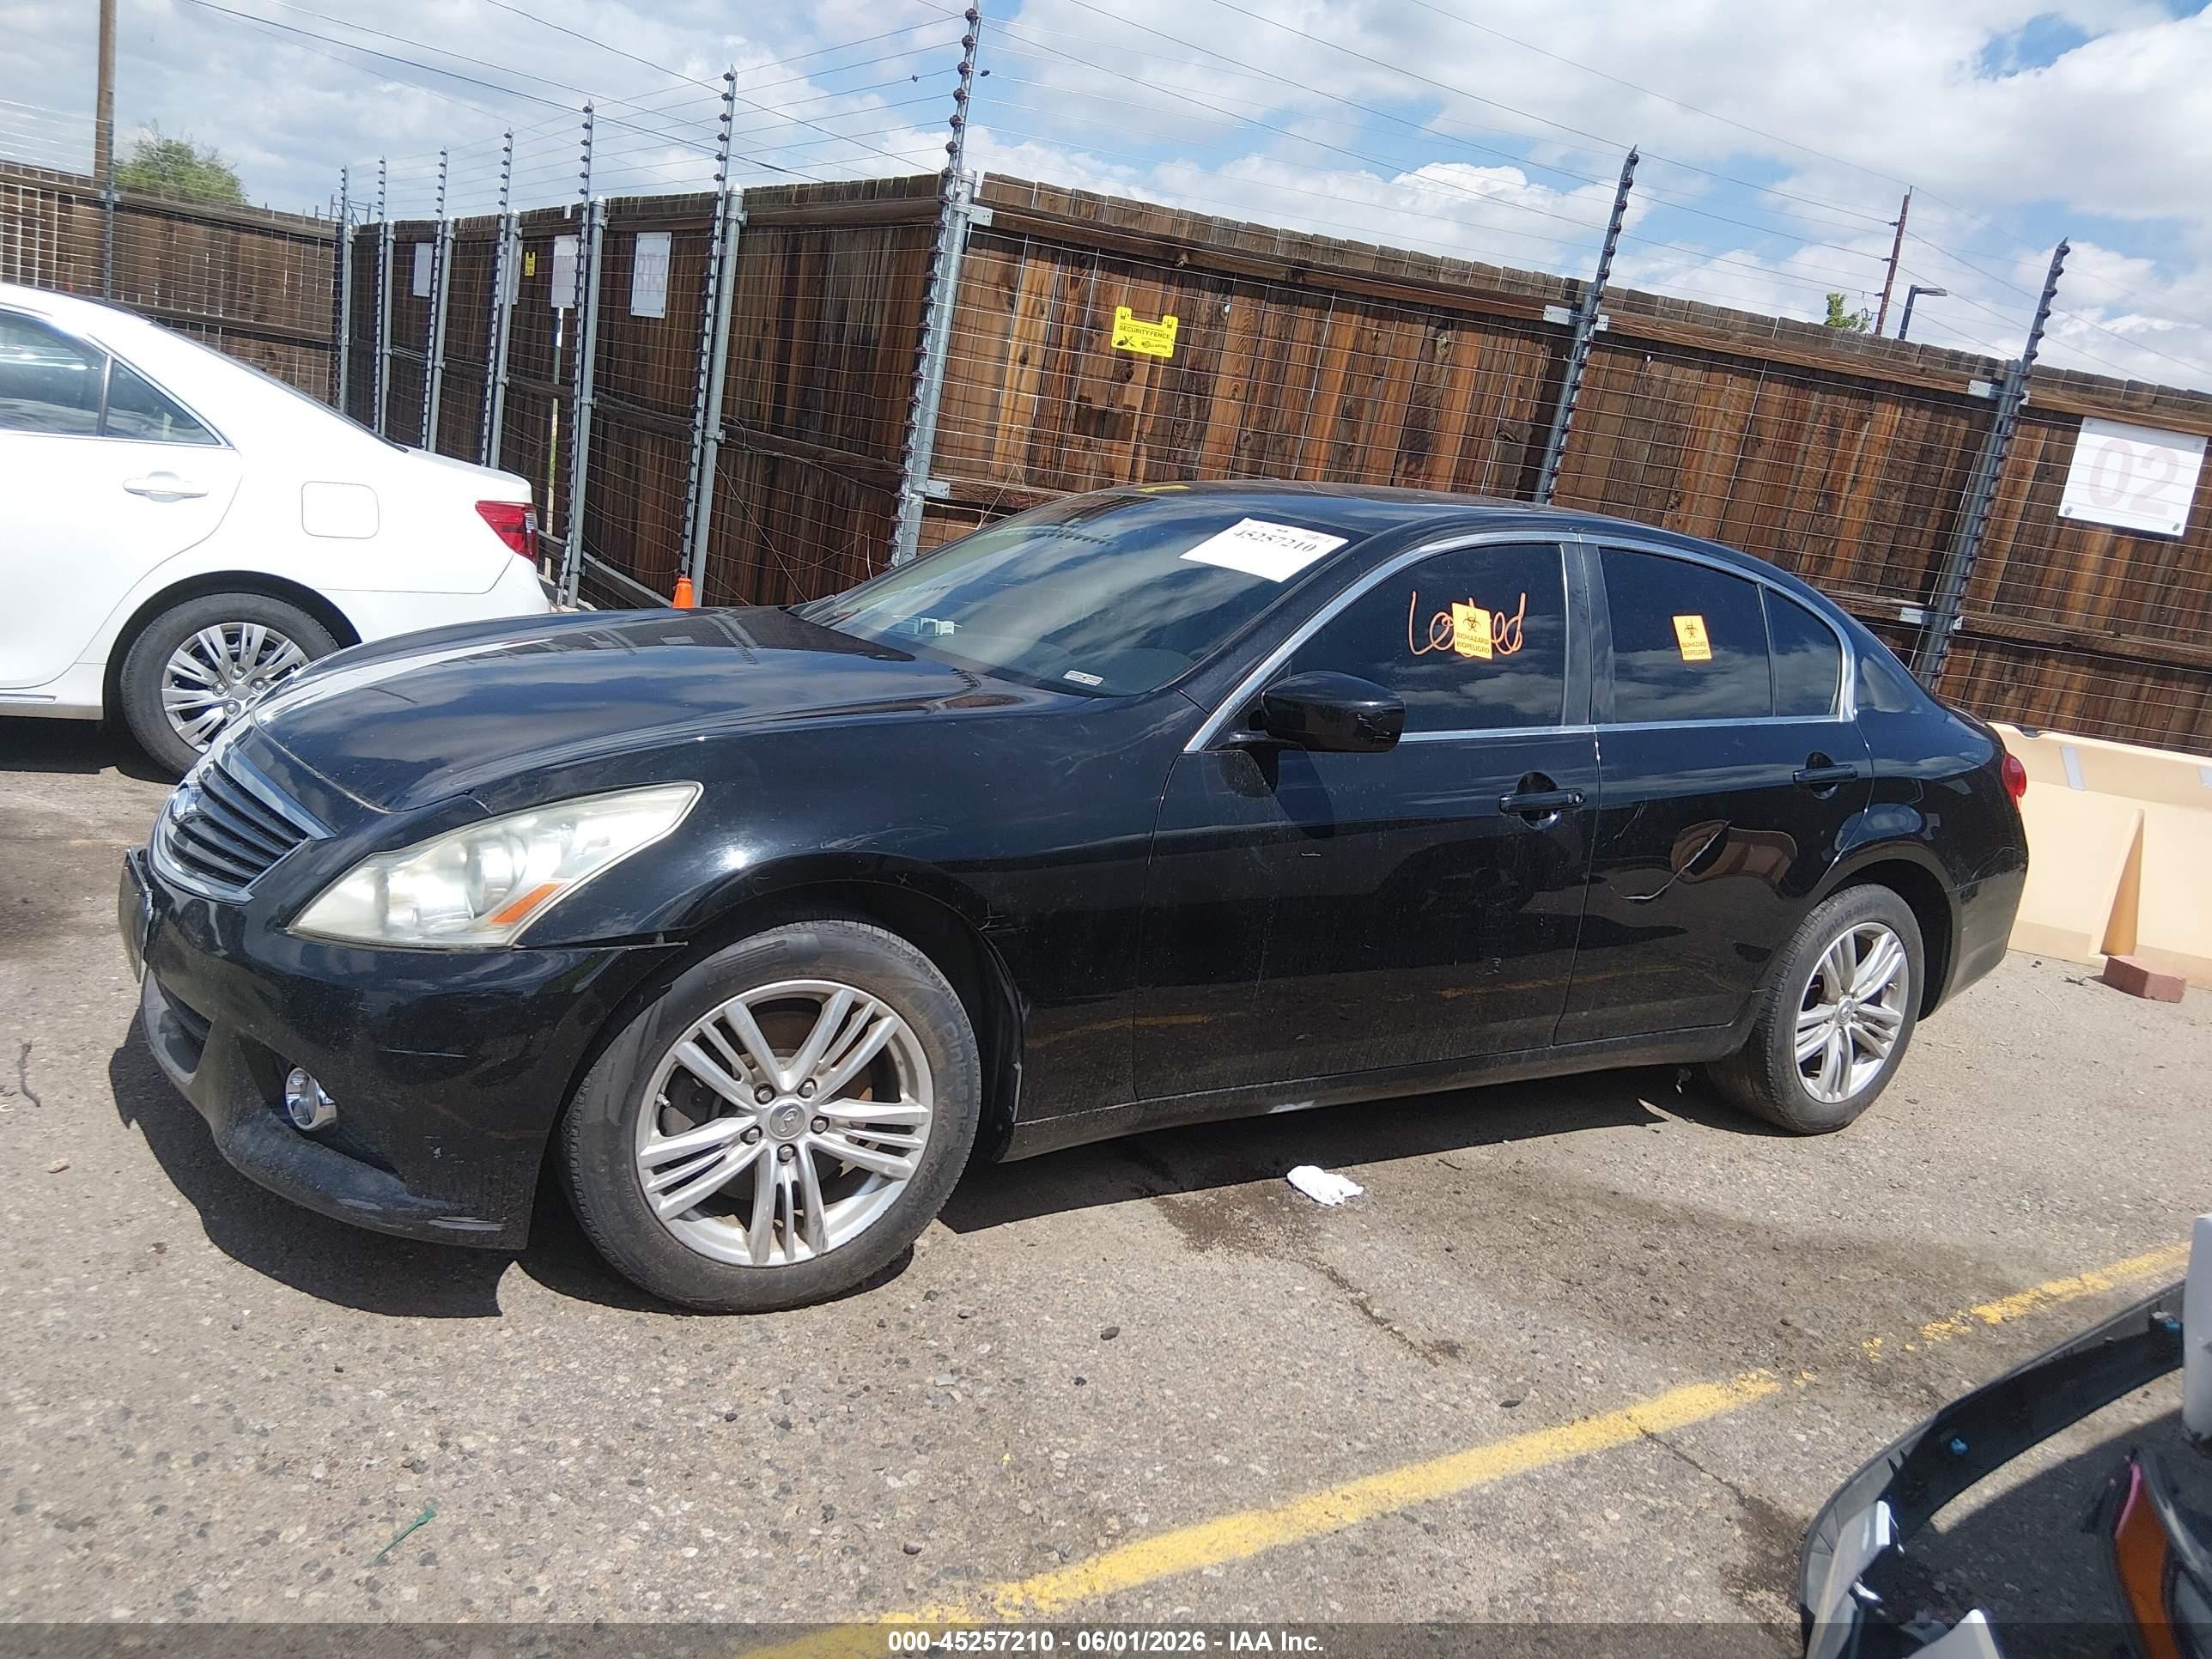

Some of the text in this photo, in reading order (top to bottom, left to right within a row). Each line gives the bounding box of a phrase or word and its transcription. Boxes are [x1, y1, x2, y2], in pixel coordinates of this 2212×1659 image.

[1119, 325, 1150, 337] SECURITY
[1150, 330, 1170, 339] FENCE
[2087, 439, 2179, 516] 02
[1455, 631, 1489, 645] BIOHAZARD
[1456, 641, 1490, 653] BIOPELIGRO
